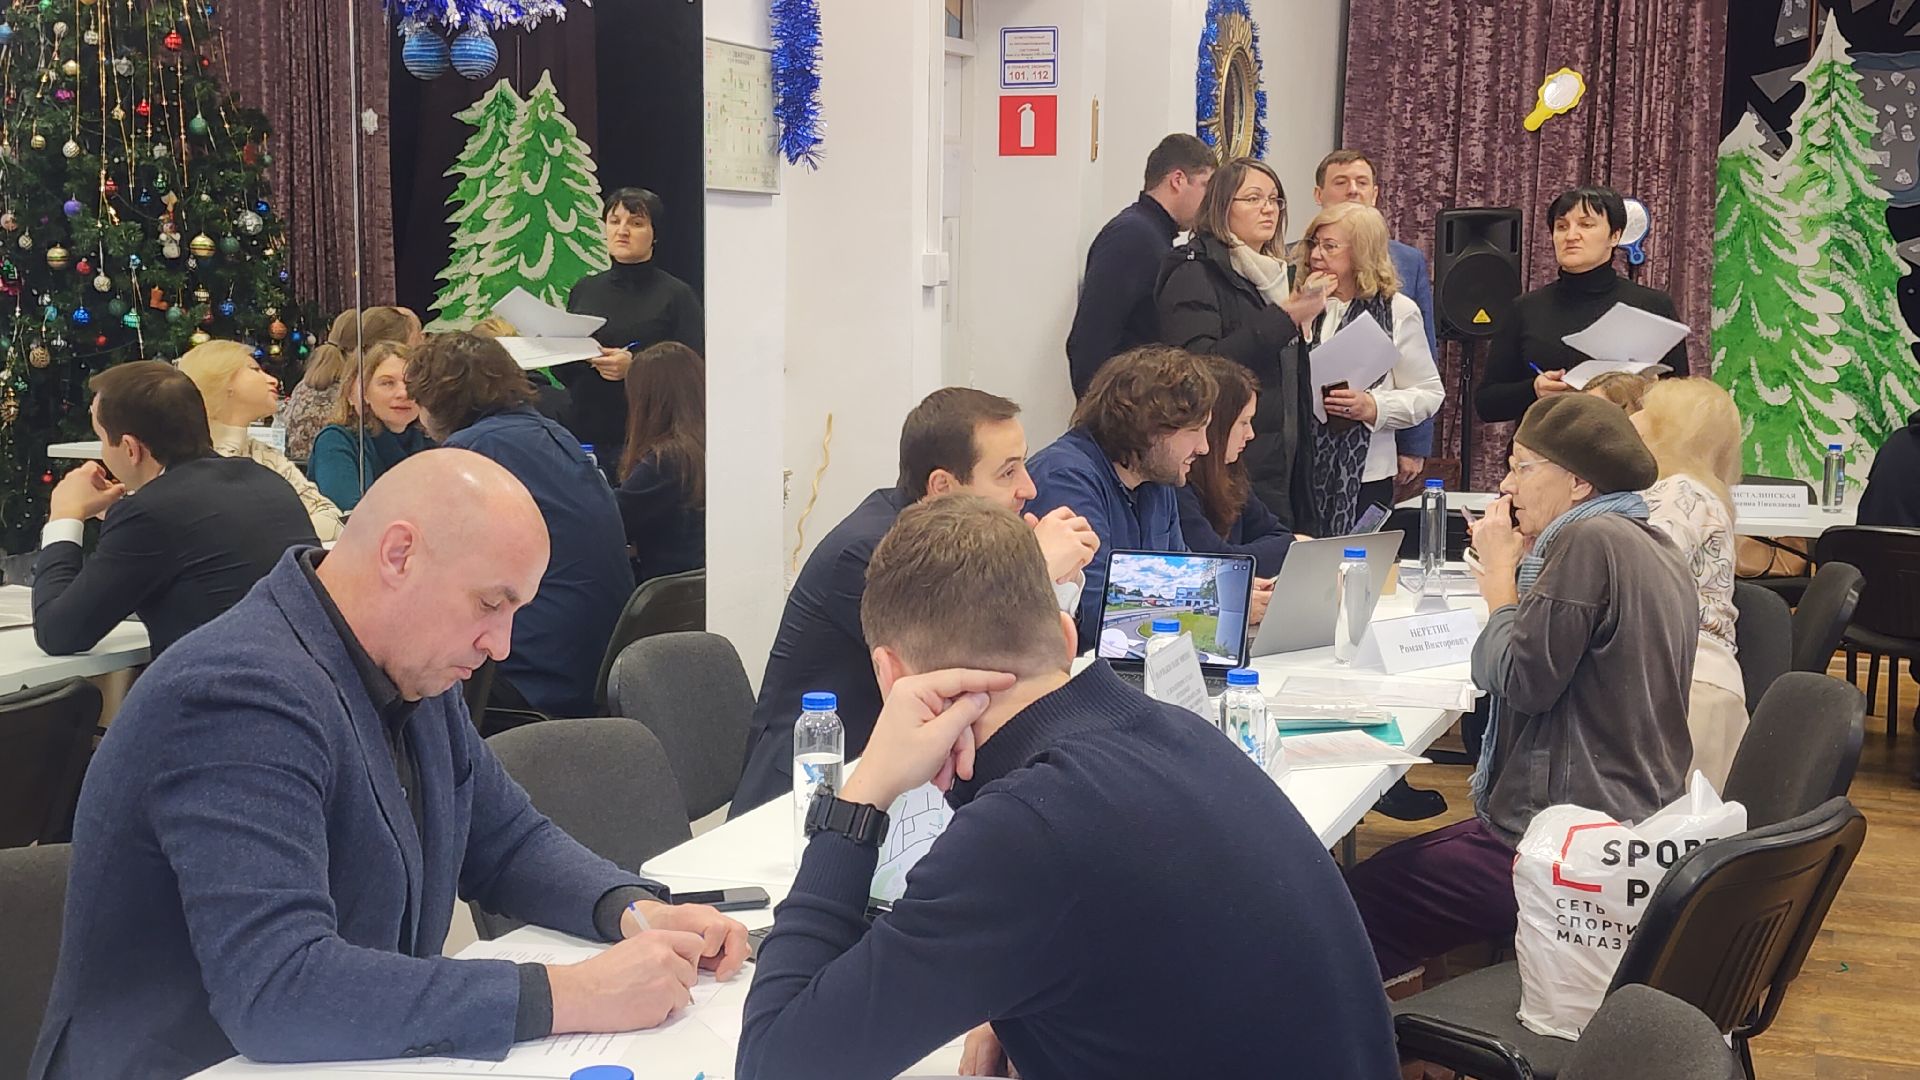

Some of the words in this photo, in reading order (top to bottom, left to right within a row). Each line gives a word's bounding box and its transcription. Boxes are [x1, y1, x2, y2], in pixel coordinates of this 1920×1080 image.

[1009, 71, 1028, 81] 101,
[1032, 70, 1049, 80] 112
[1399, 643, 1424, 654] Роман
[1424, 637, 1469, 650] Викторович
[1556, 898, 1606, 915] СЕТЬ
[1556, 930, 1632, 951] МАГАЗ
